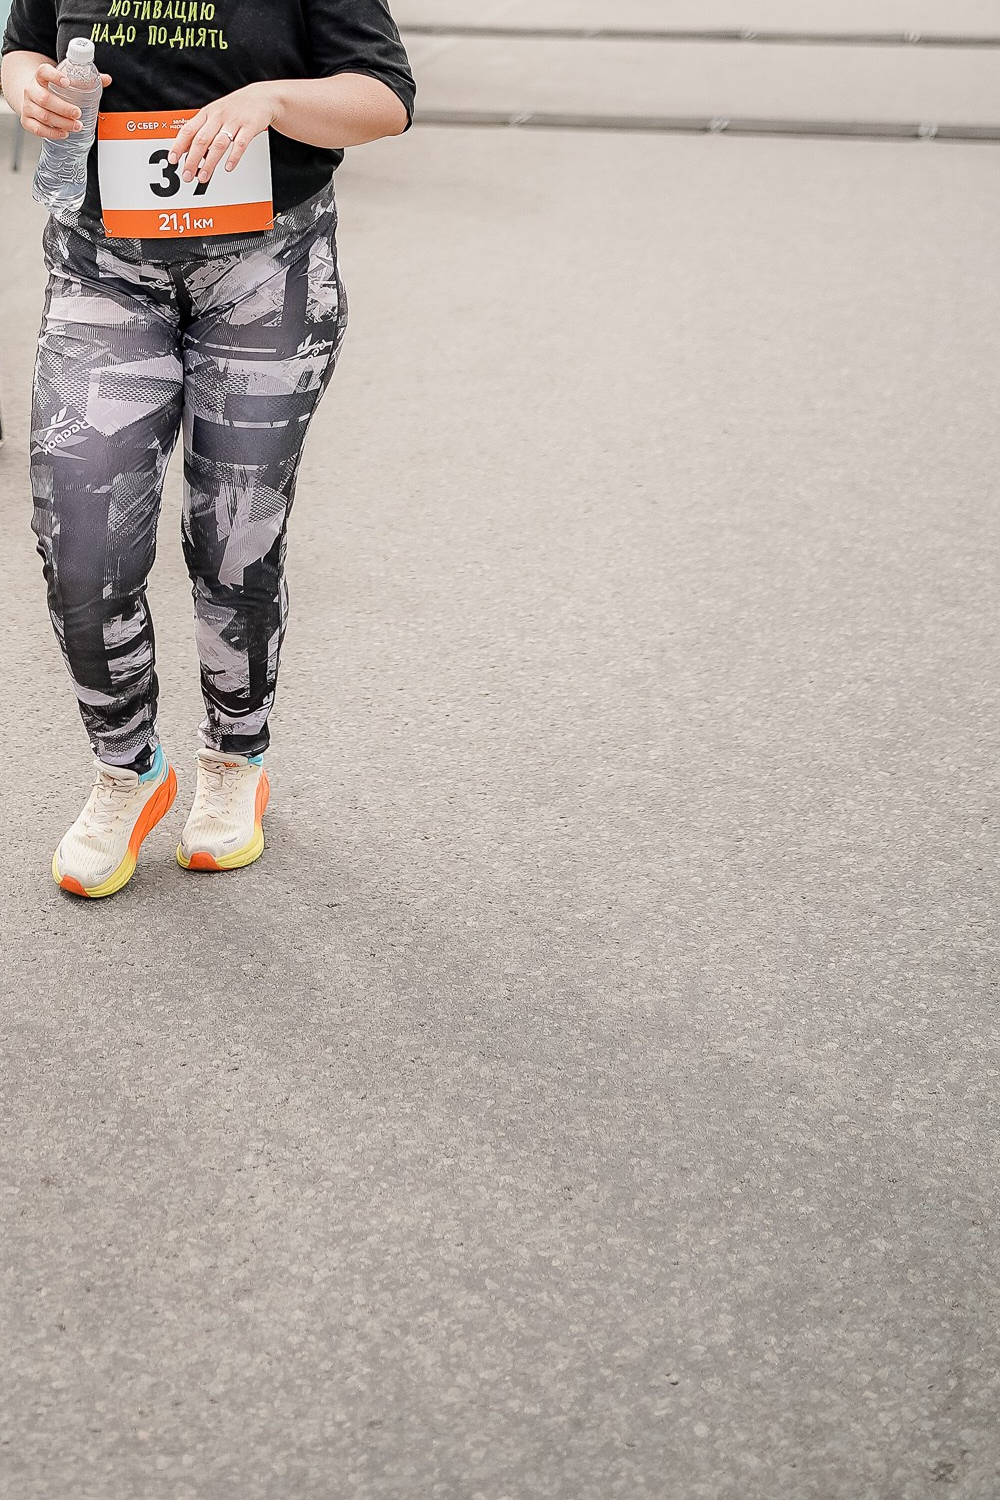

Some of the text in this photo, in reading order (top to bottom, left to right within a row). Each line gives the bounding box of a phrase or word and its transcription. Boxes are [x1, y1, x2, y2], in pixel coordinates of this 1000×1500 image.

[107, 0, 215, 23] МОТИВАЦИЮ
[90, 23, 229, 50] НАДО ПОДНЯТЬ
[137, 121, 159, 130] СБЕР
[158, 213, 190, 233] 21,1
[42, 419, 93, 455] Reebok
